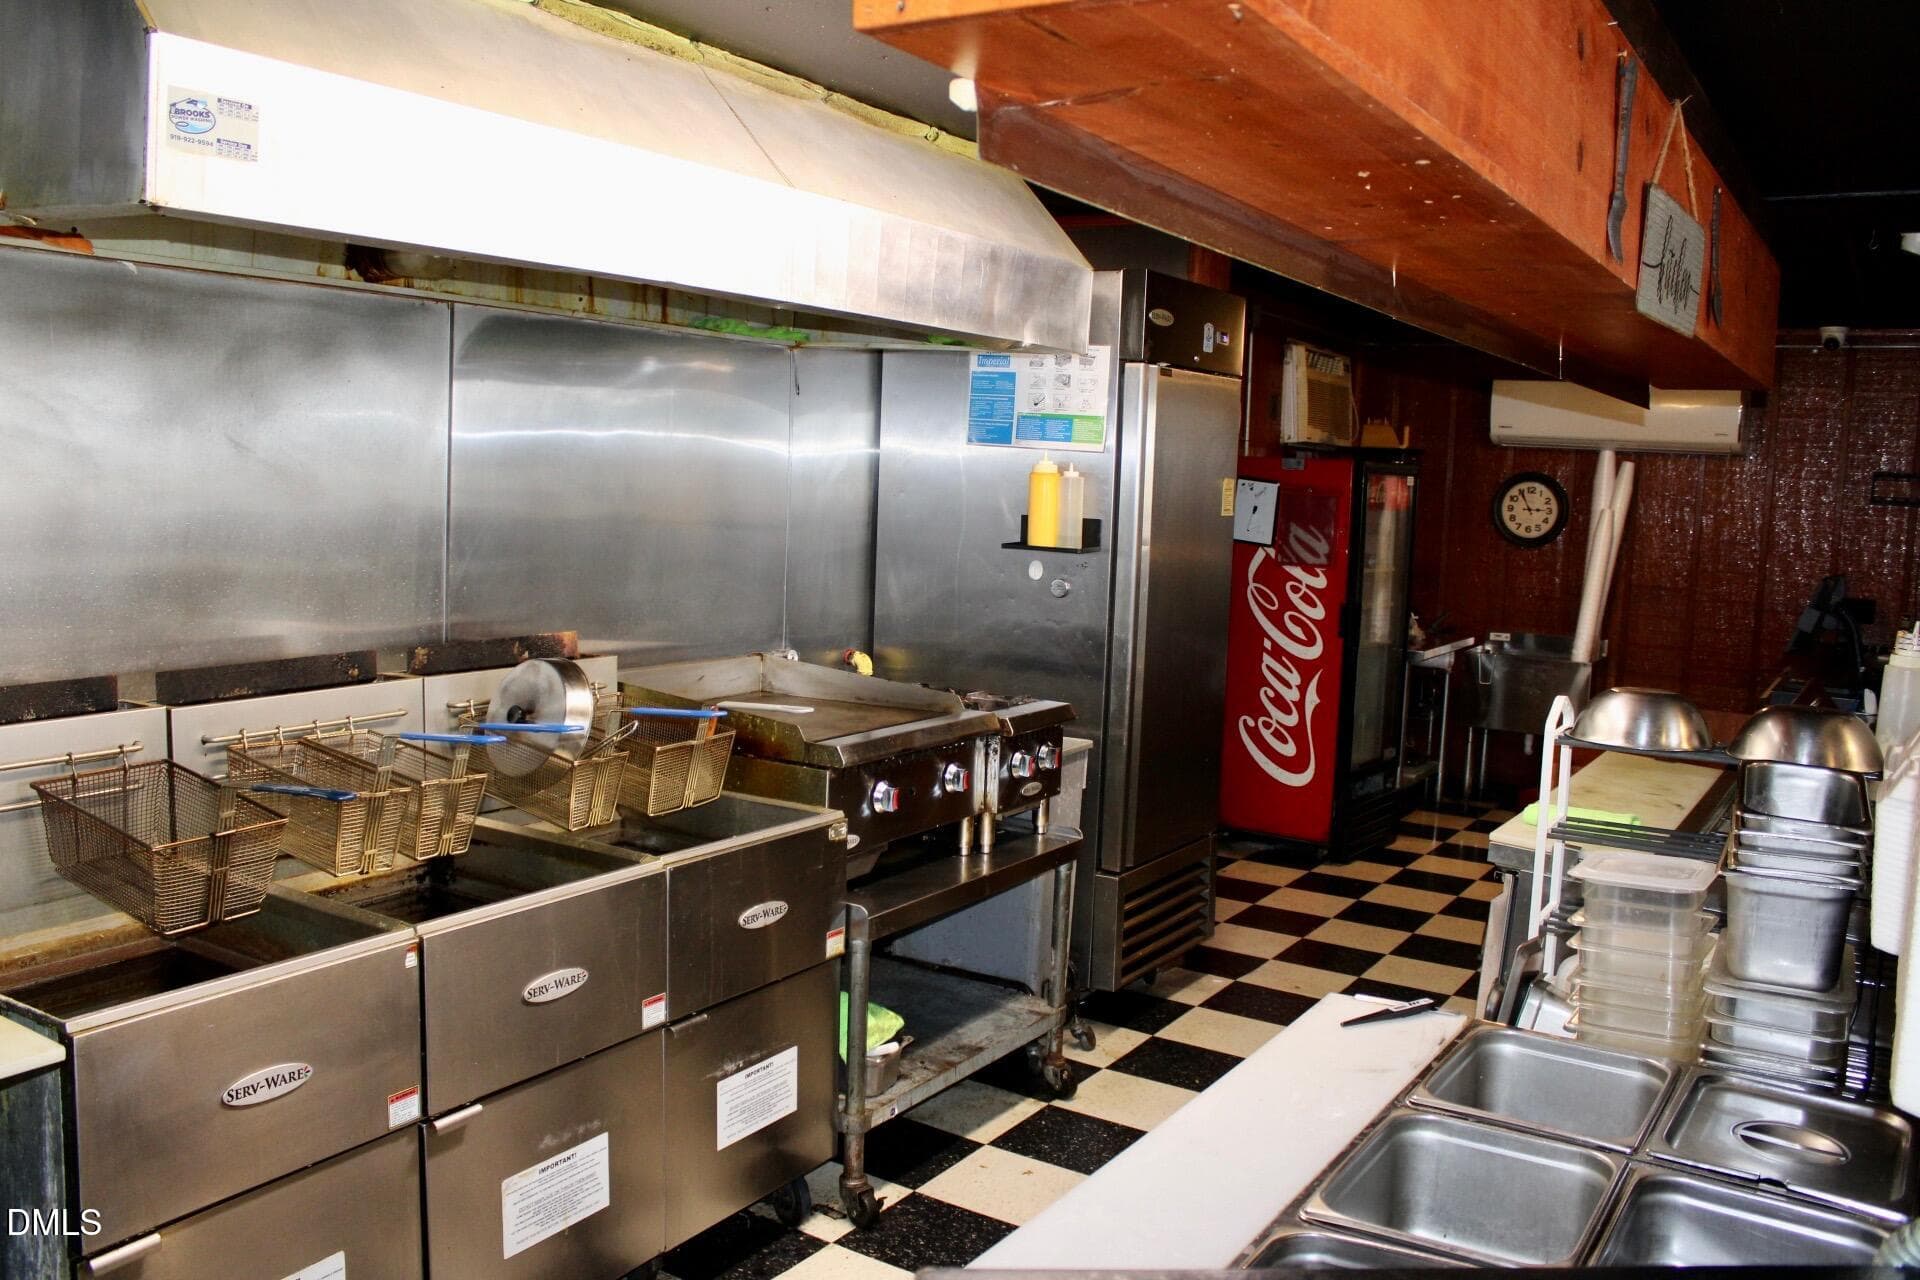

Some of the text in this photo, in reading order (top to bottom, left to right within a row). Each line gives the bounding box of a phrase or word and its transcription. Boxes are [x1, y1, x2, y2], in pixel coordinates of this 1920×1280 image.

[174, 108, 210, 118] BROOKS
[978, 355, 1010, 367] Imperial
[1527, 486, 1537, 494] 12
[1510, 495, 1519, 503] 10
[1545, 497, 1551, 505] 2
[1509, 514, 1516, 522] 8
[1525, 525, 1532, 533] 6
[1534, 524, 1542, 532] 5
[1238, 521, 1330, 787] Coca-Cola
[742, 905, 785, 926] SERV-WARE
[526, 973, 583, 1000] SERV-WARE
[226, 1068, 304, 1103] SERV-WARE
[538, 1152, 577, 1175] IMPORTANT!
